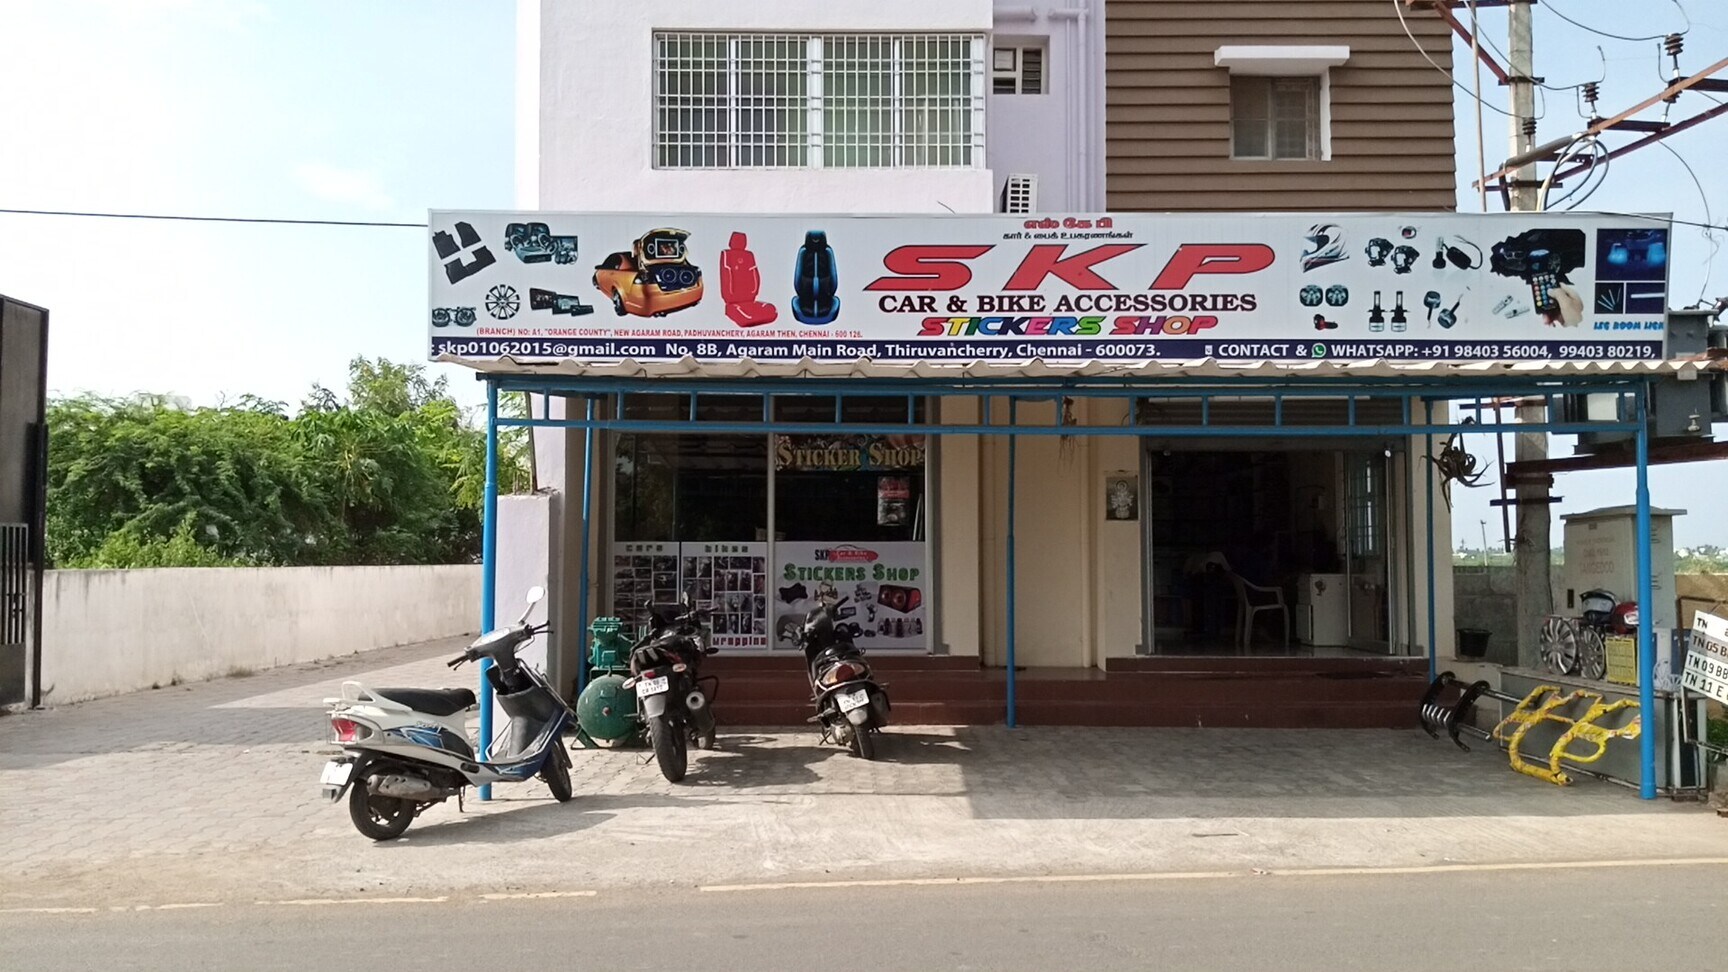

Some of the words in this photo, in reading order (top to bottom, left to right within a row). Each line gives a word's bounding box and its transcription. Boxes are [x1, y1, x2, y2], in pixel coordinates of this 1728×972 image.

[863, 243, 1275, 291] SKP
[879, 295, 938, 313] CAR
[946, 295, 967, 313] &
[977, 295, 1046, 313] BIKE
[1053, 294, 1257, 313] ACCESSORIES
[477, 327, 516, 336] (BRANCH)
[614, 329, 629, 337] NEW
[631, 329, 660, 337] AGARAM
[799, 330, 830, 338] CHENNAI
[917, 316, 1106, 336] STICKERS
[1109, 315, 1218, 335] SHOP
[438, 341, 656, 357] skp01062015@gmail.com
[696, 343, 722, 357] 8B,
[726, 343, 789, 357] Agaram
[792, 344, 832, 356] Main
[836, 344, 881, 357] Road,
[885, 344, 1013, 358] Thiruvancherry,
[1016, 344, 1082, 356] Chennai
[1095, 344, 1161, 356] 600073.
[1218, 344, 1290, 356] CONTACT
[1295, 344, 1307, 356] &
[1331, 344, 1418, 357] WHATSAPP:
[1421, 345, 1449, 357] +91
[1454, 345, 1499, 357] 98403
[1502, 345, 1552, 359] 56004,
[1559, 345, 1604, 358] 99403
[1607, 345, 1656, 359] 80219,
[778, 442, 861, 466] STICKER
[869, 442, 922, 466] SHOP
[783, 563, 866, 581] STICKERS
[873, 563, 920, 581] SHOP
[1697, 617, 1708, 629] TN
[1693, 635, 1704, 649] TN
[1689, 654, 1700, 669] TN
[1684, 671, 1697, 687] TN
